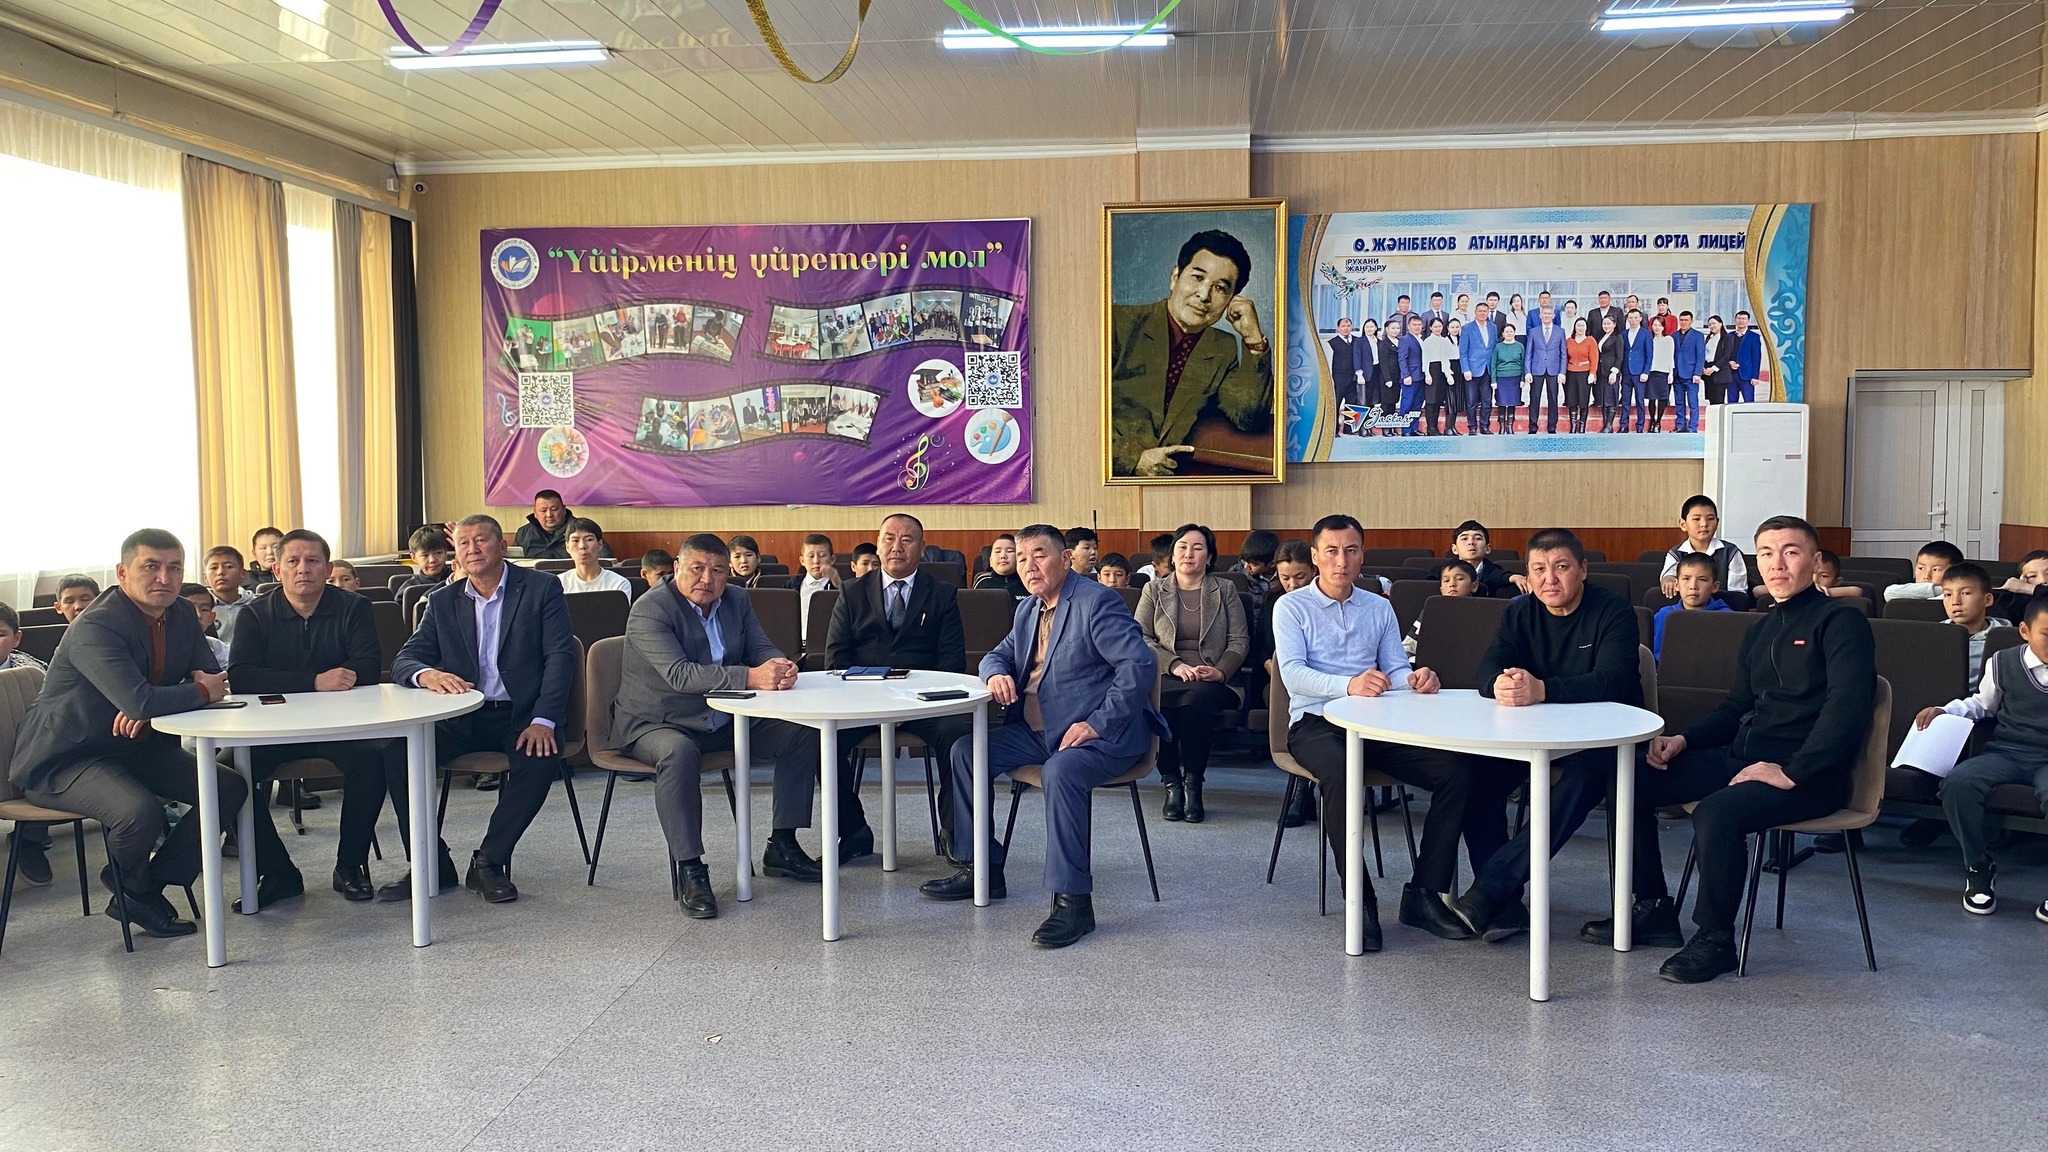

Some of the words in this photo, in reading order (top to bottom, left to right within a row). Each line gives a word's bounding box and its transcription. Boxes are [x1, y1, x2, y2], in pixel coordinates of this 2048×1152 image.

[1372, 236, 1457, 252] ЖӘНІБЕКОВ
[1468, 234, 1551, 253] АТЫНДАҒЫ
[1590, 234, 1647, 250] ЖАЛПЫ
[1653, 234, 1689, 250] ОРТА
[1697, 232, 1746, 252] ЛИЦЕЙ
[749, 243, 910, 279] үйретері
[1346, 258, 1379, 266] РУХАНИ
[1345, 265, 1387, 273] ЖАҢҒЫРУ
